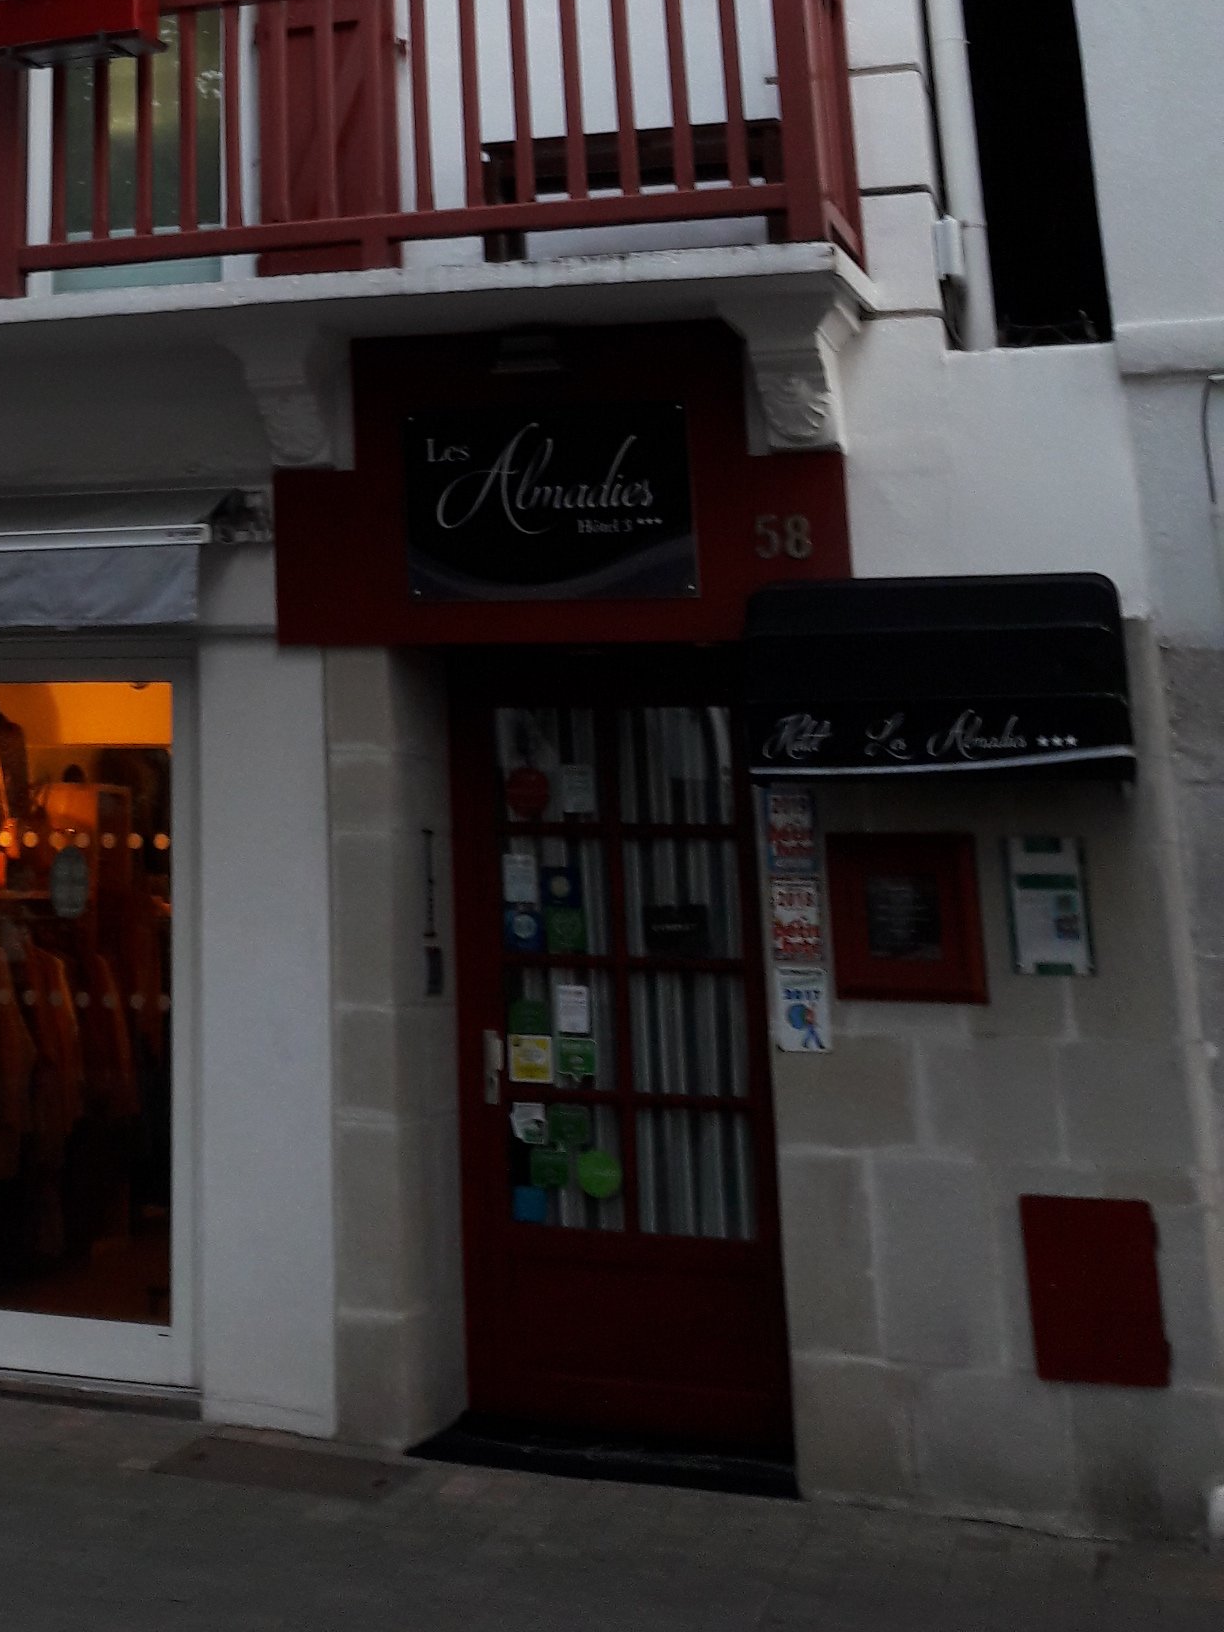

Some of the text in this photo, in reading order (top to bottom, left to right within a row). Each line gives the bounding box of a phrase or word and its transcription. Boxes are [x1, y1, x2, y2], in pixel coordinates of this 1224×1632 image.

[426, 438, 470, 462] Les
[436, 422, 654, 535] Almadies
[754, 513, 813, 560] 58
